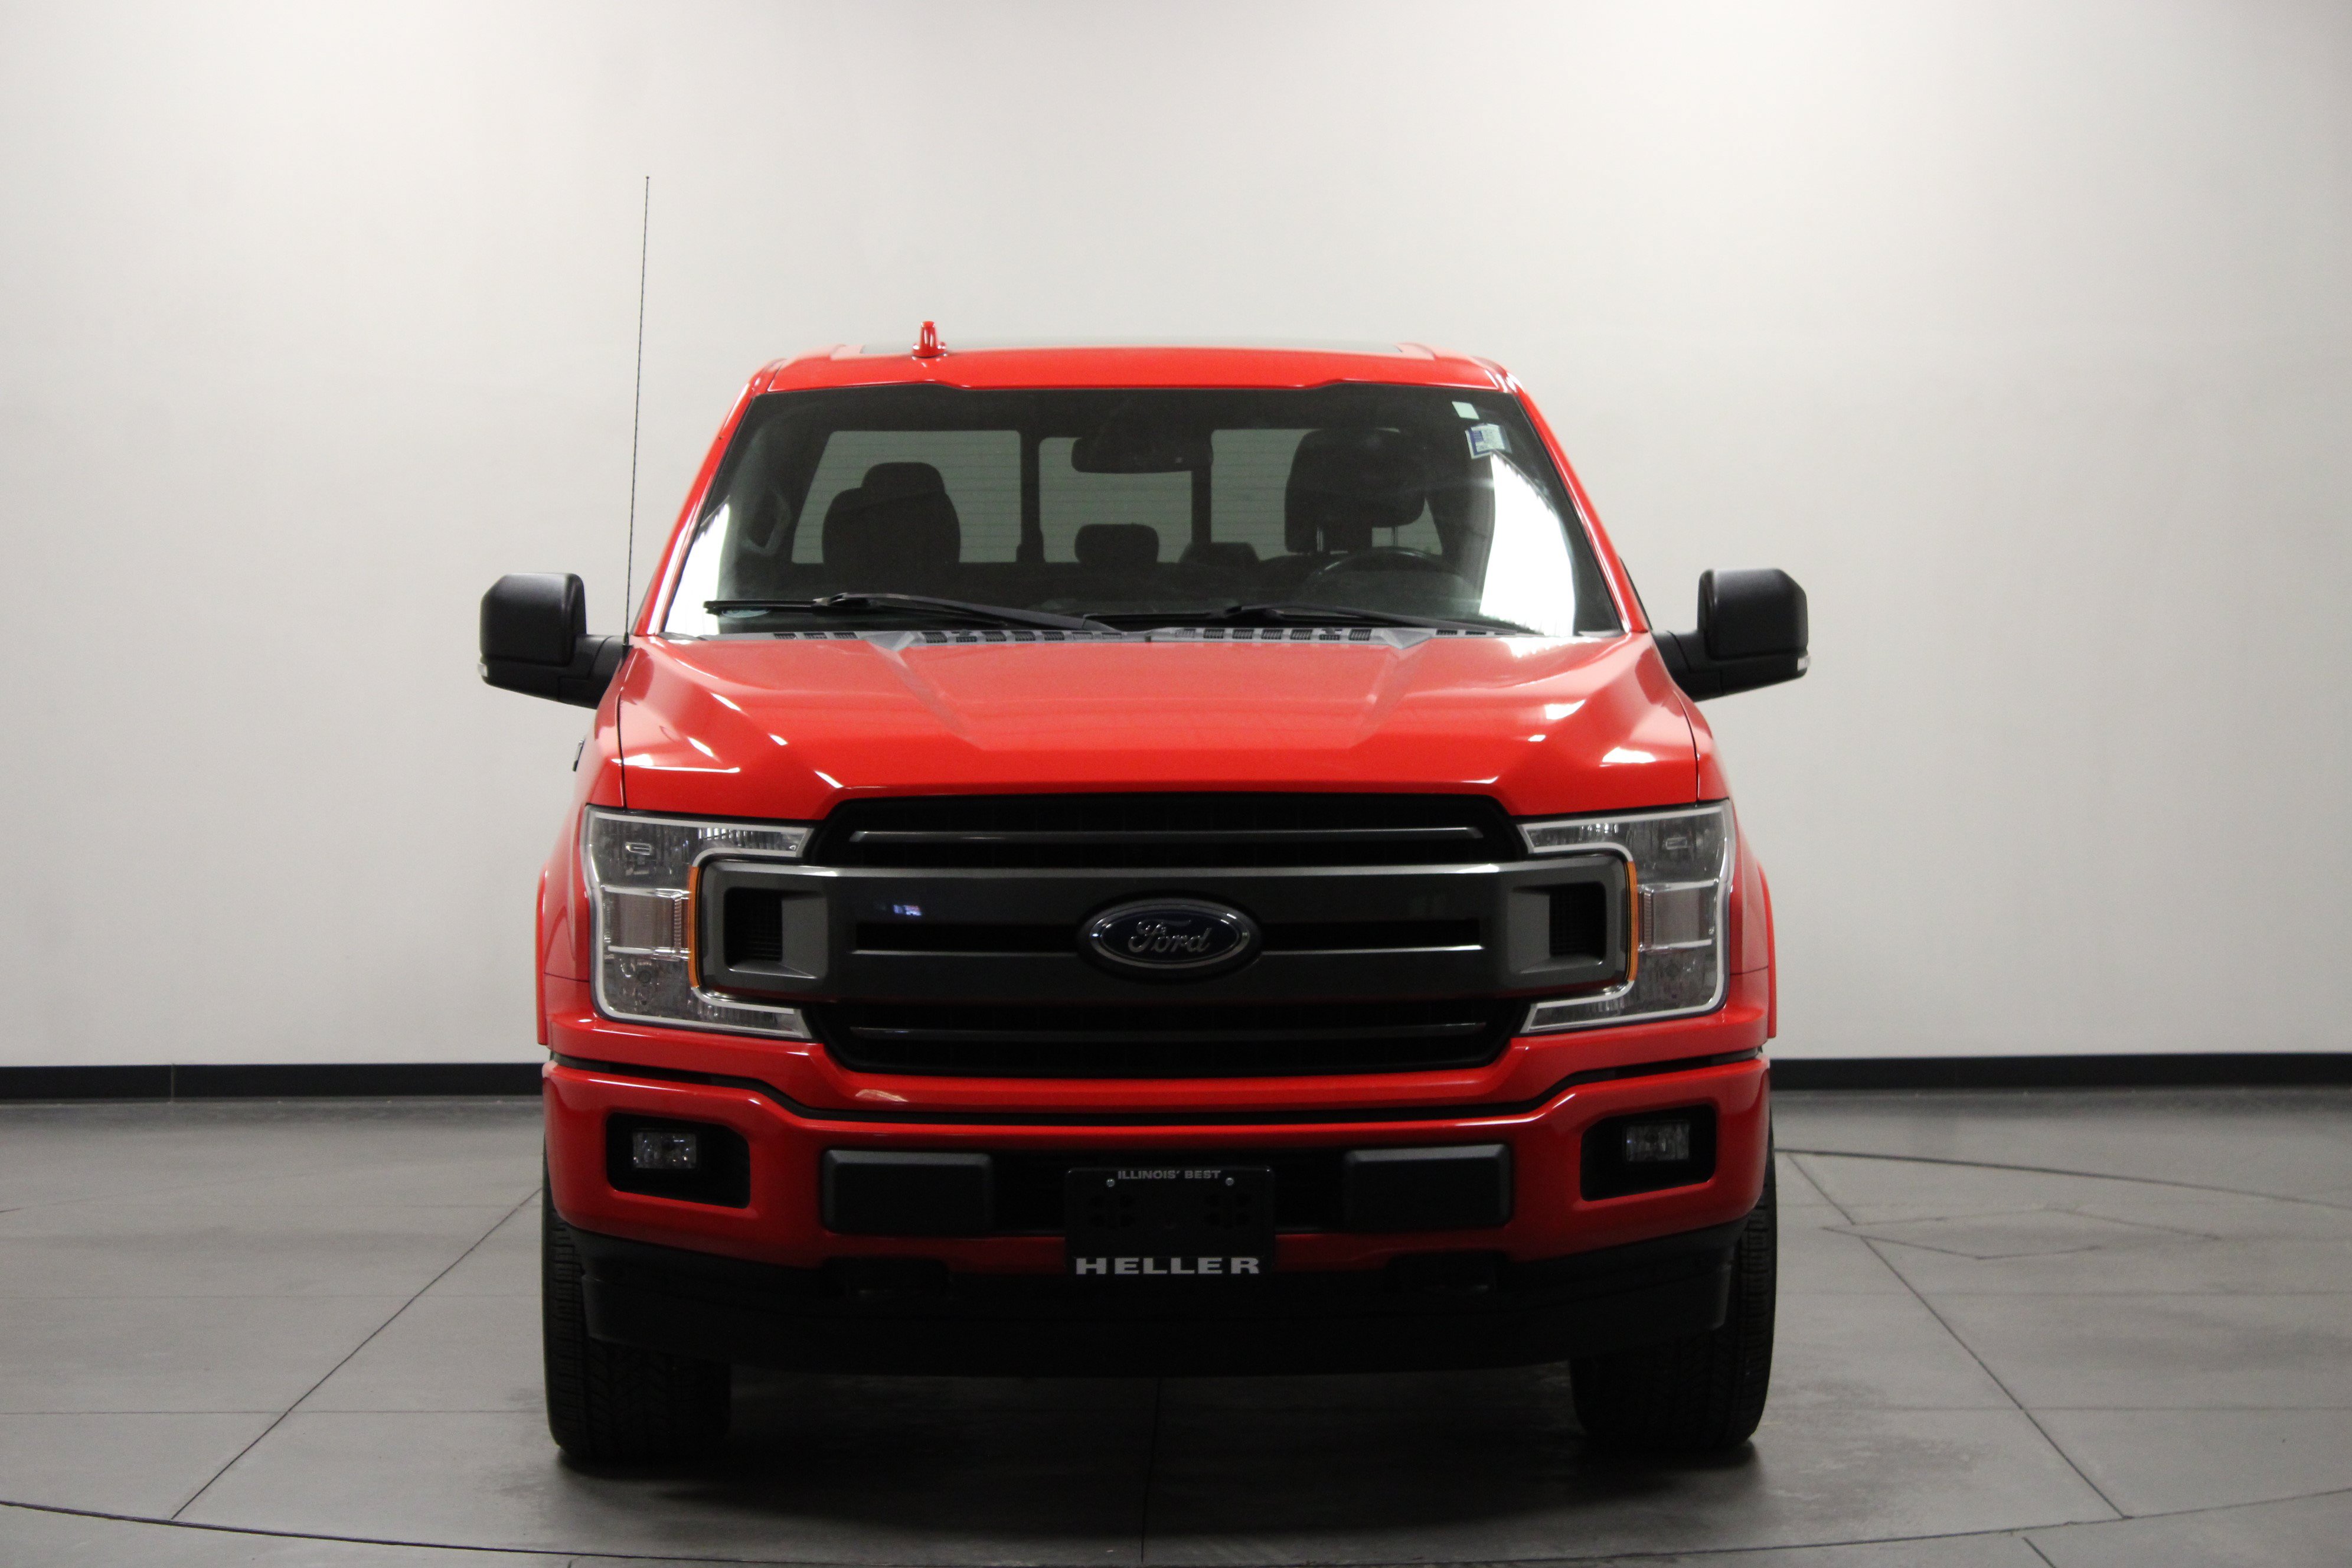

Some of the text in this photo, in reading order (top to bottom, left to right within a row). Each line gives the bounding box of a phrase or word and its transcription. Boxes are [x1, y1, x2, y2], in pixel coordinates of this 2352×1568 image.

[1128, 919, 1212, 953] Ford
[1118, 1170, 1221, 1179] ILLINOIS' BEST
[1076, 1257, 1259, 1275] HELLER
